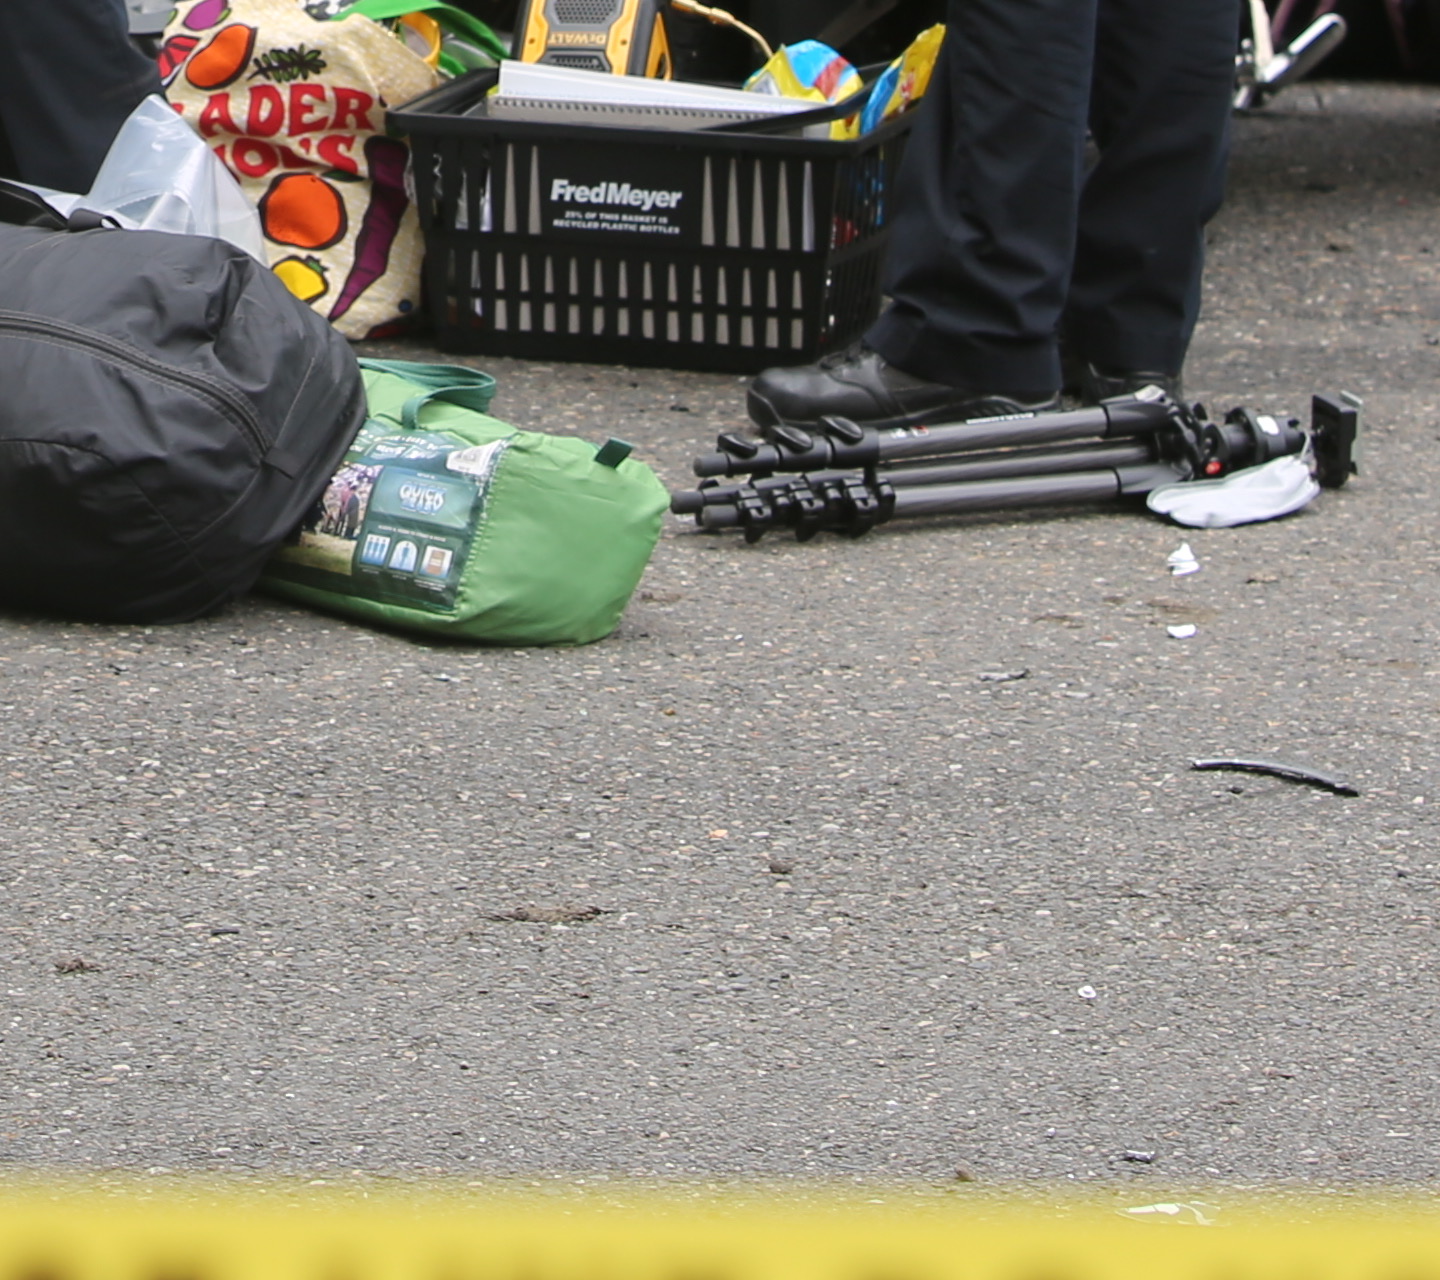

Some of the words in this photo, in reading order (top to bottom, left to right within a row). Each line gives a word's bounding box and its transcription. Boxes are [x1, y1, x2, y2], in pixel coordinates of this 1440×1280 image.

[552, 219, 600, 229] RECYCLED
[601, 222, 638, 231] PLASTIC
[639, 225, 681, 234] BOTTLES
